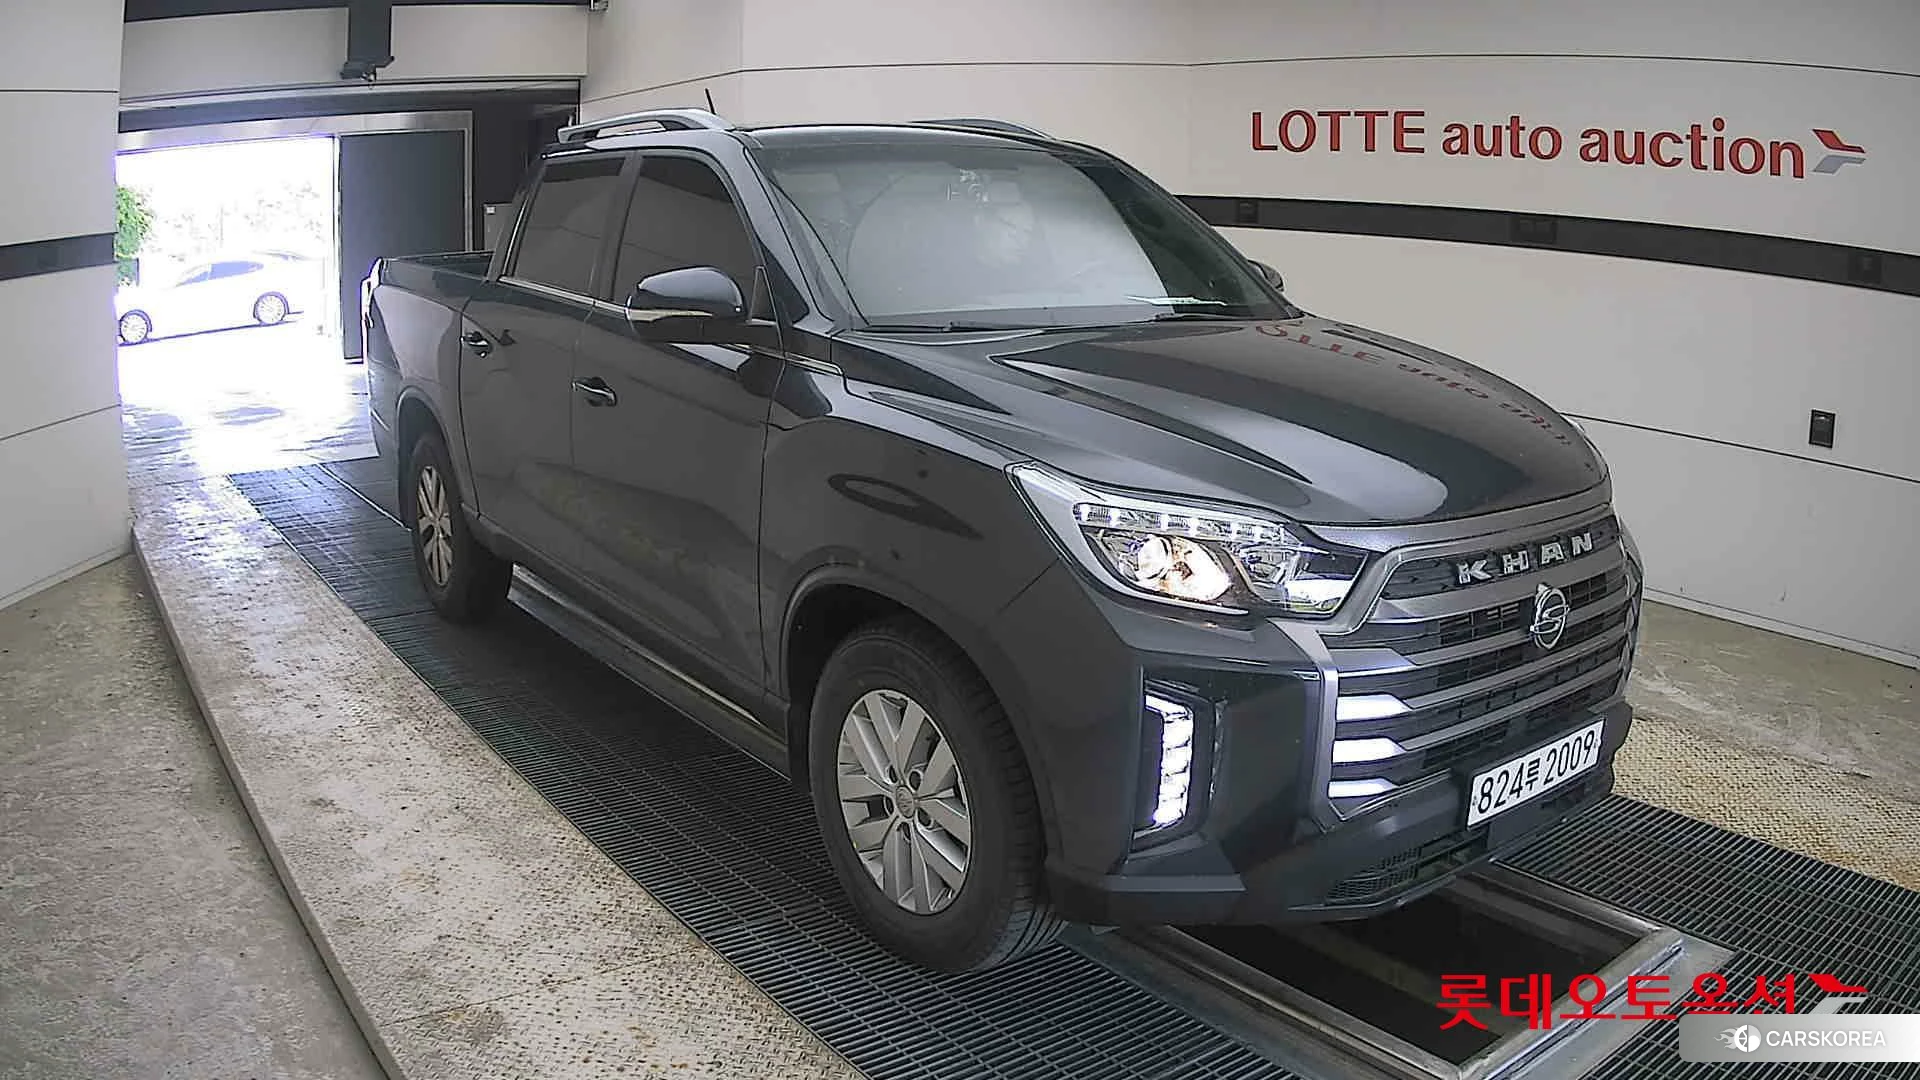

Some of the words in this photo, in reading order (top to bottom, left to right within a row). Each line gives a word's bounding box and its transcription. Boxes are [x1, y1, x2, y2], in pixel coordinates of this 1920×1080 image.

[1252, 110, 1426, 153] LOTTE
[1442, 115, 1562, 160] auto
[1579, 117, 1805, 179] auction
[1456, 532, 1593, 585] KHAN
